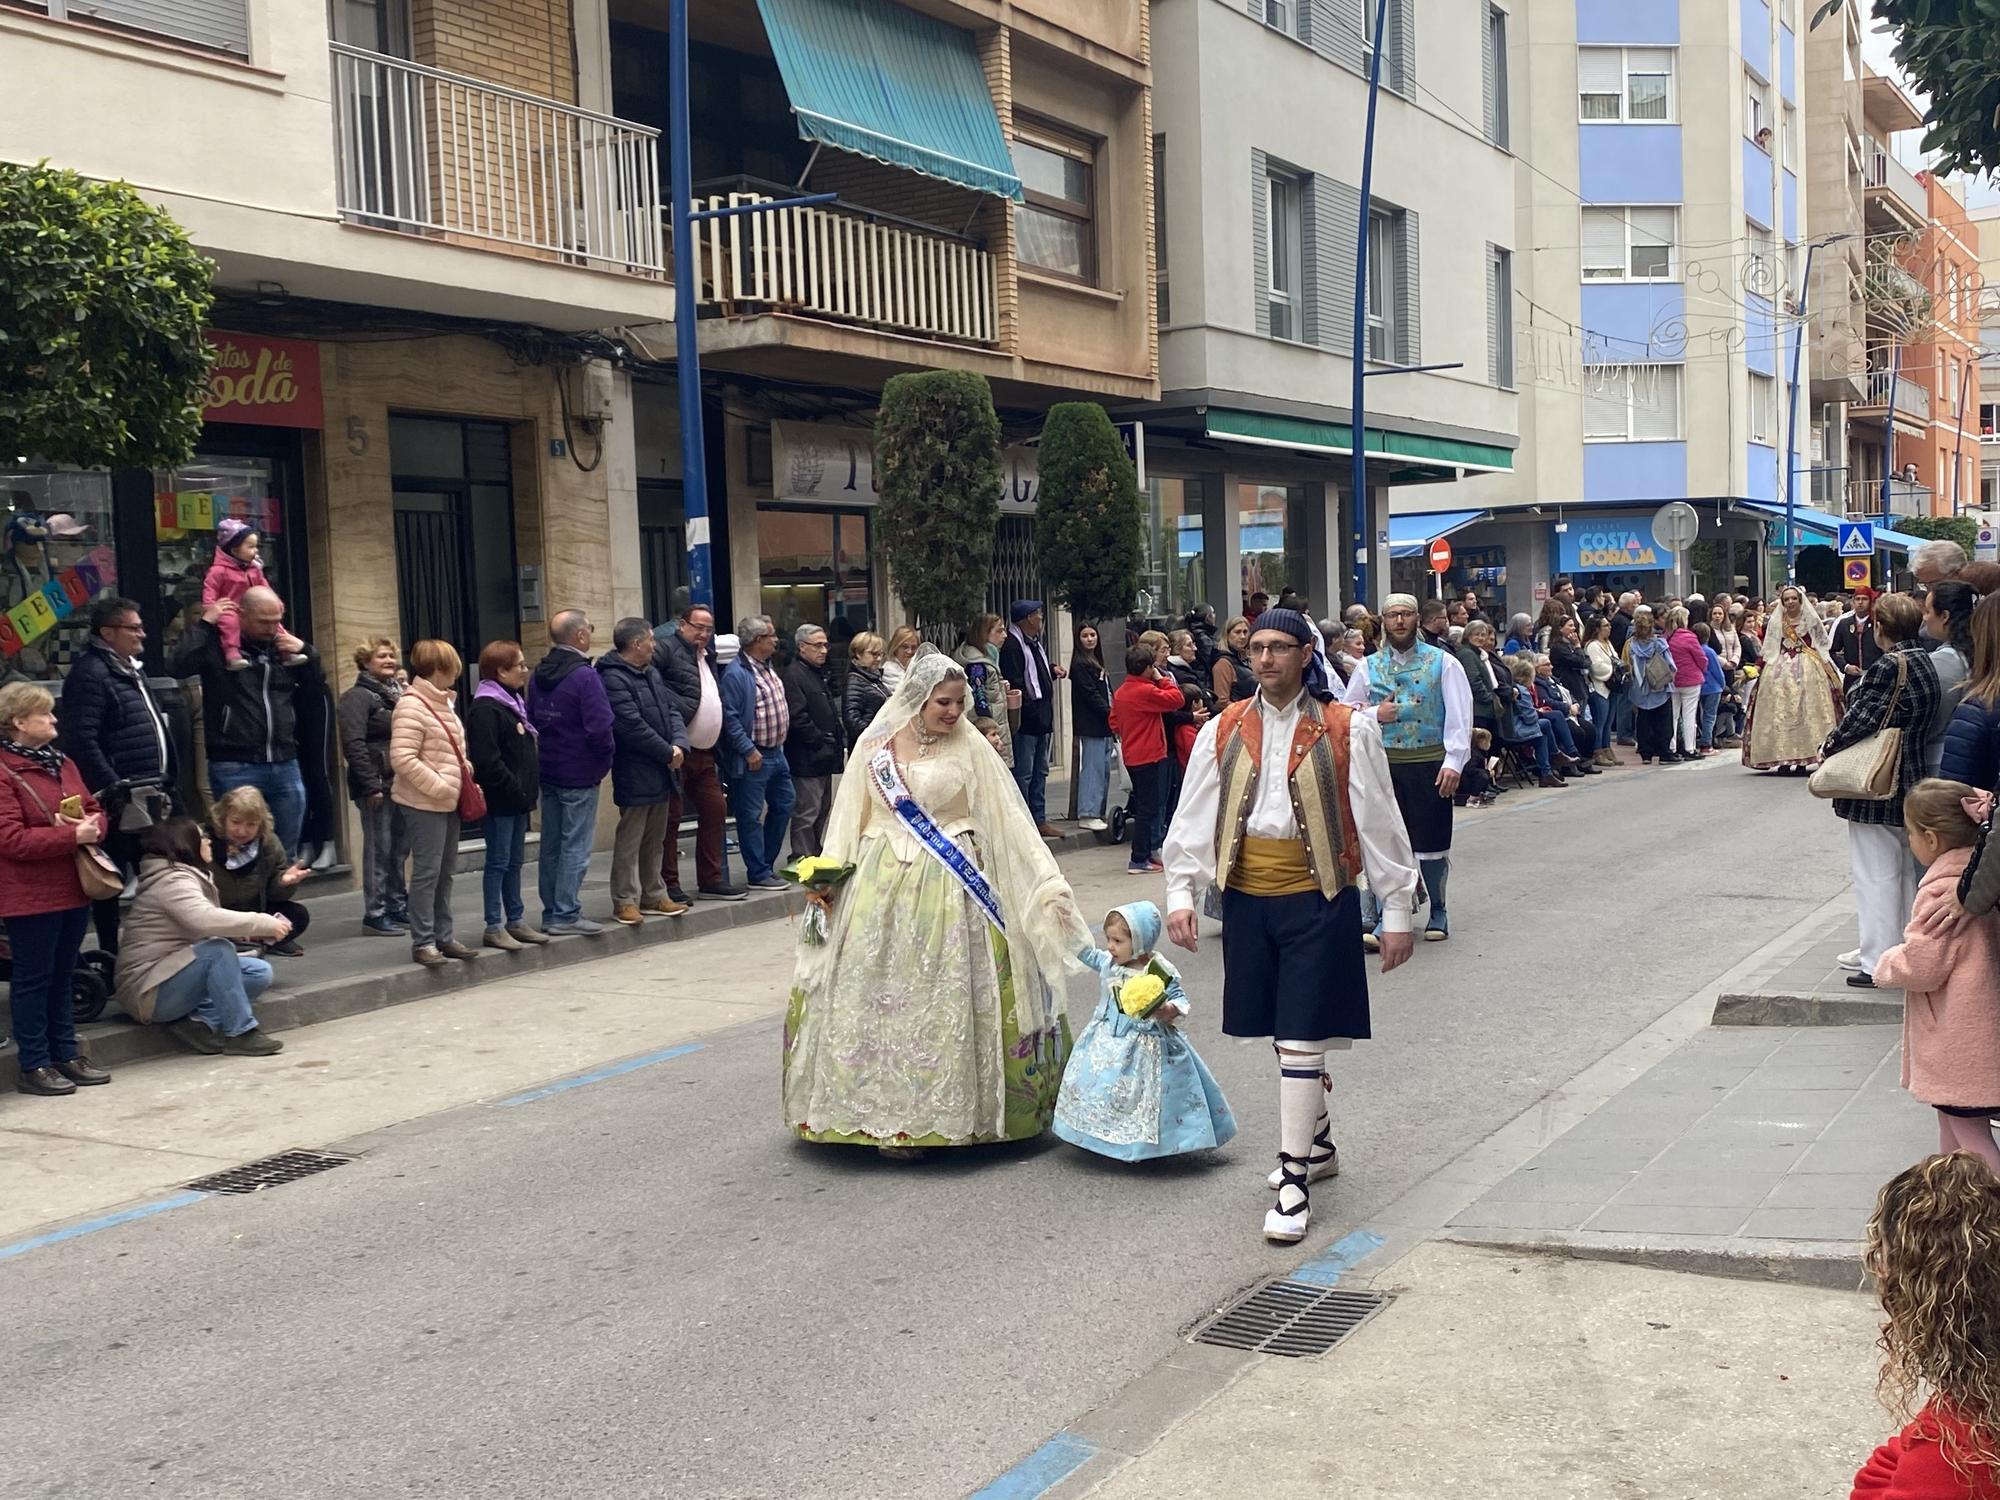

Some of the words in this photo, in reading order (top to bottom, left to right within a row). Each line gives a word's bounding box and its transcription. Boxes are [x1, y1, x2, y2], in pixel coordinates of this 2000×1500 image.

[272, 350, 293, 371] de
[200, 347, 298, 408] oda
[347, 415, 369, 456] 5
[554, 441, 561, 455] 5
[1578, 531, 1641, 550] COSTA
[945, 847, 958, 862] de
